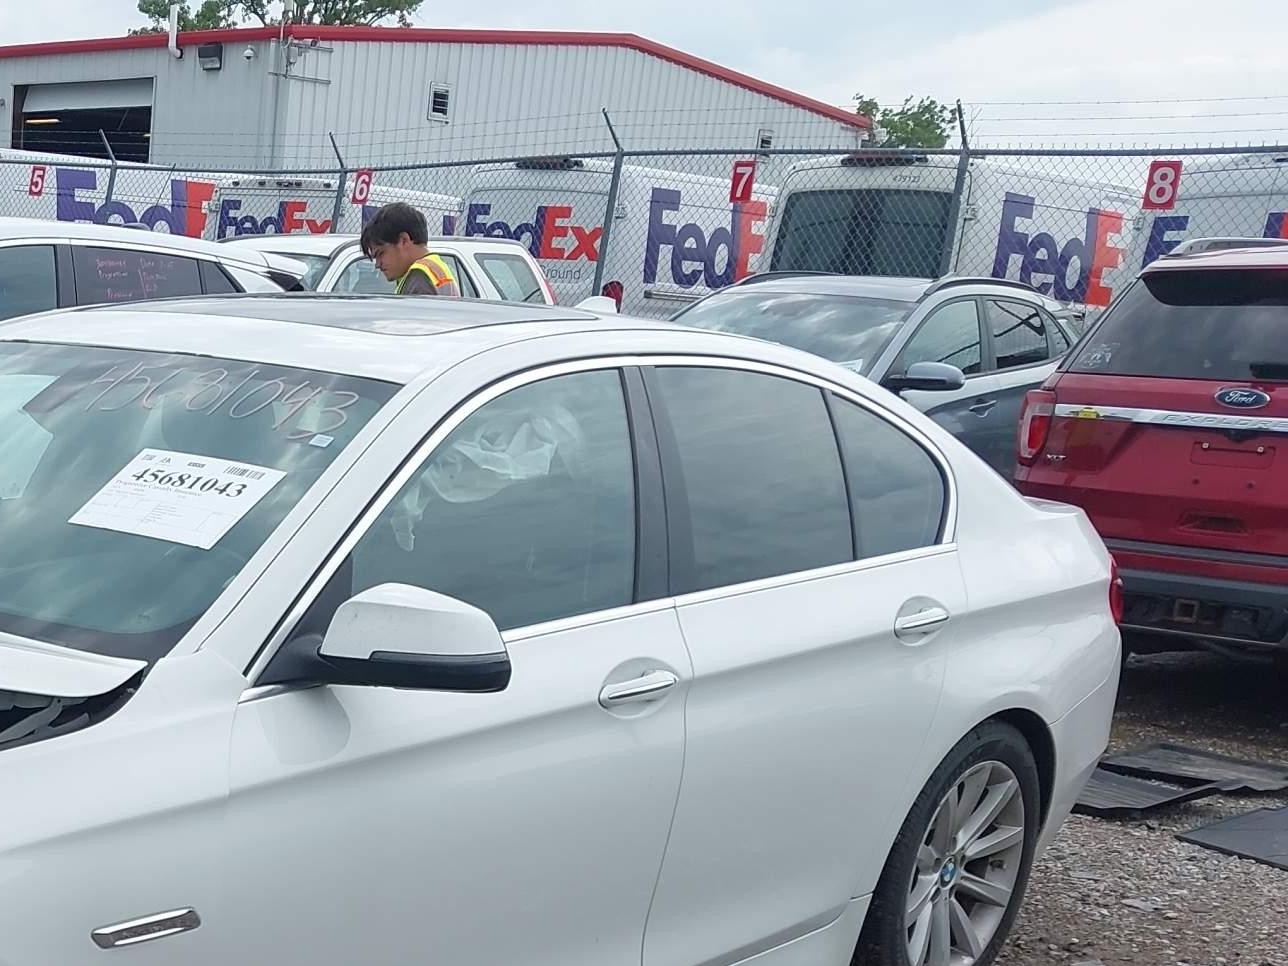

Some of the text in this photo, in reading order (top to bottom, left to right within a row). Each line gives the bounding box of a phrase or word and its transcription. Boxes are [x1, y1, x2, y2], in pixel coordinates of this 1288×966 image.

[31, 168, 45, 192] 5
[354, 174, 370, 201] 6
[735, 166, 753, 198] 7
[1149, 166, 1176, 204] 8
[1224, 390, 1256, 404] Ford
[132, 467, 248, 498] 45681043
